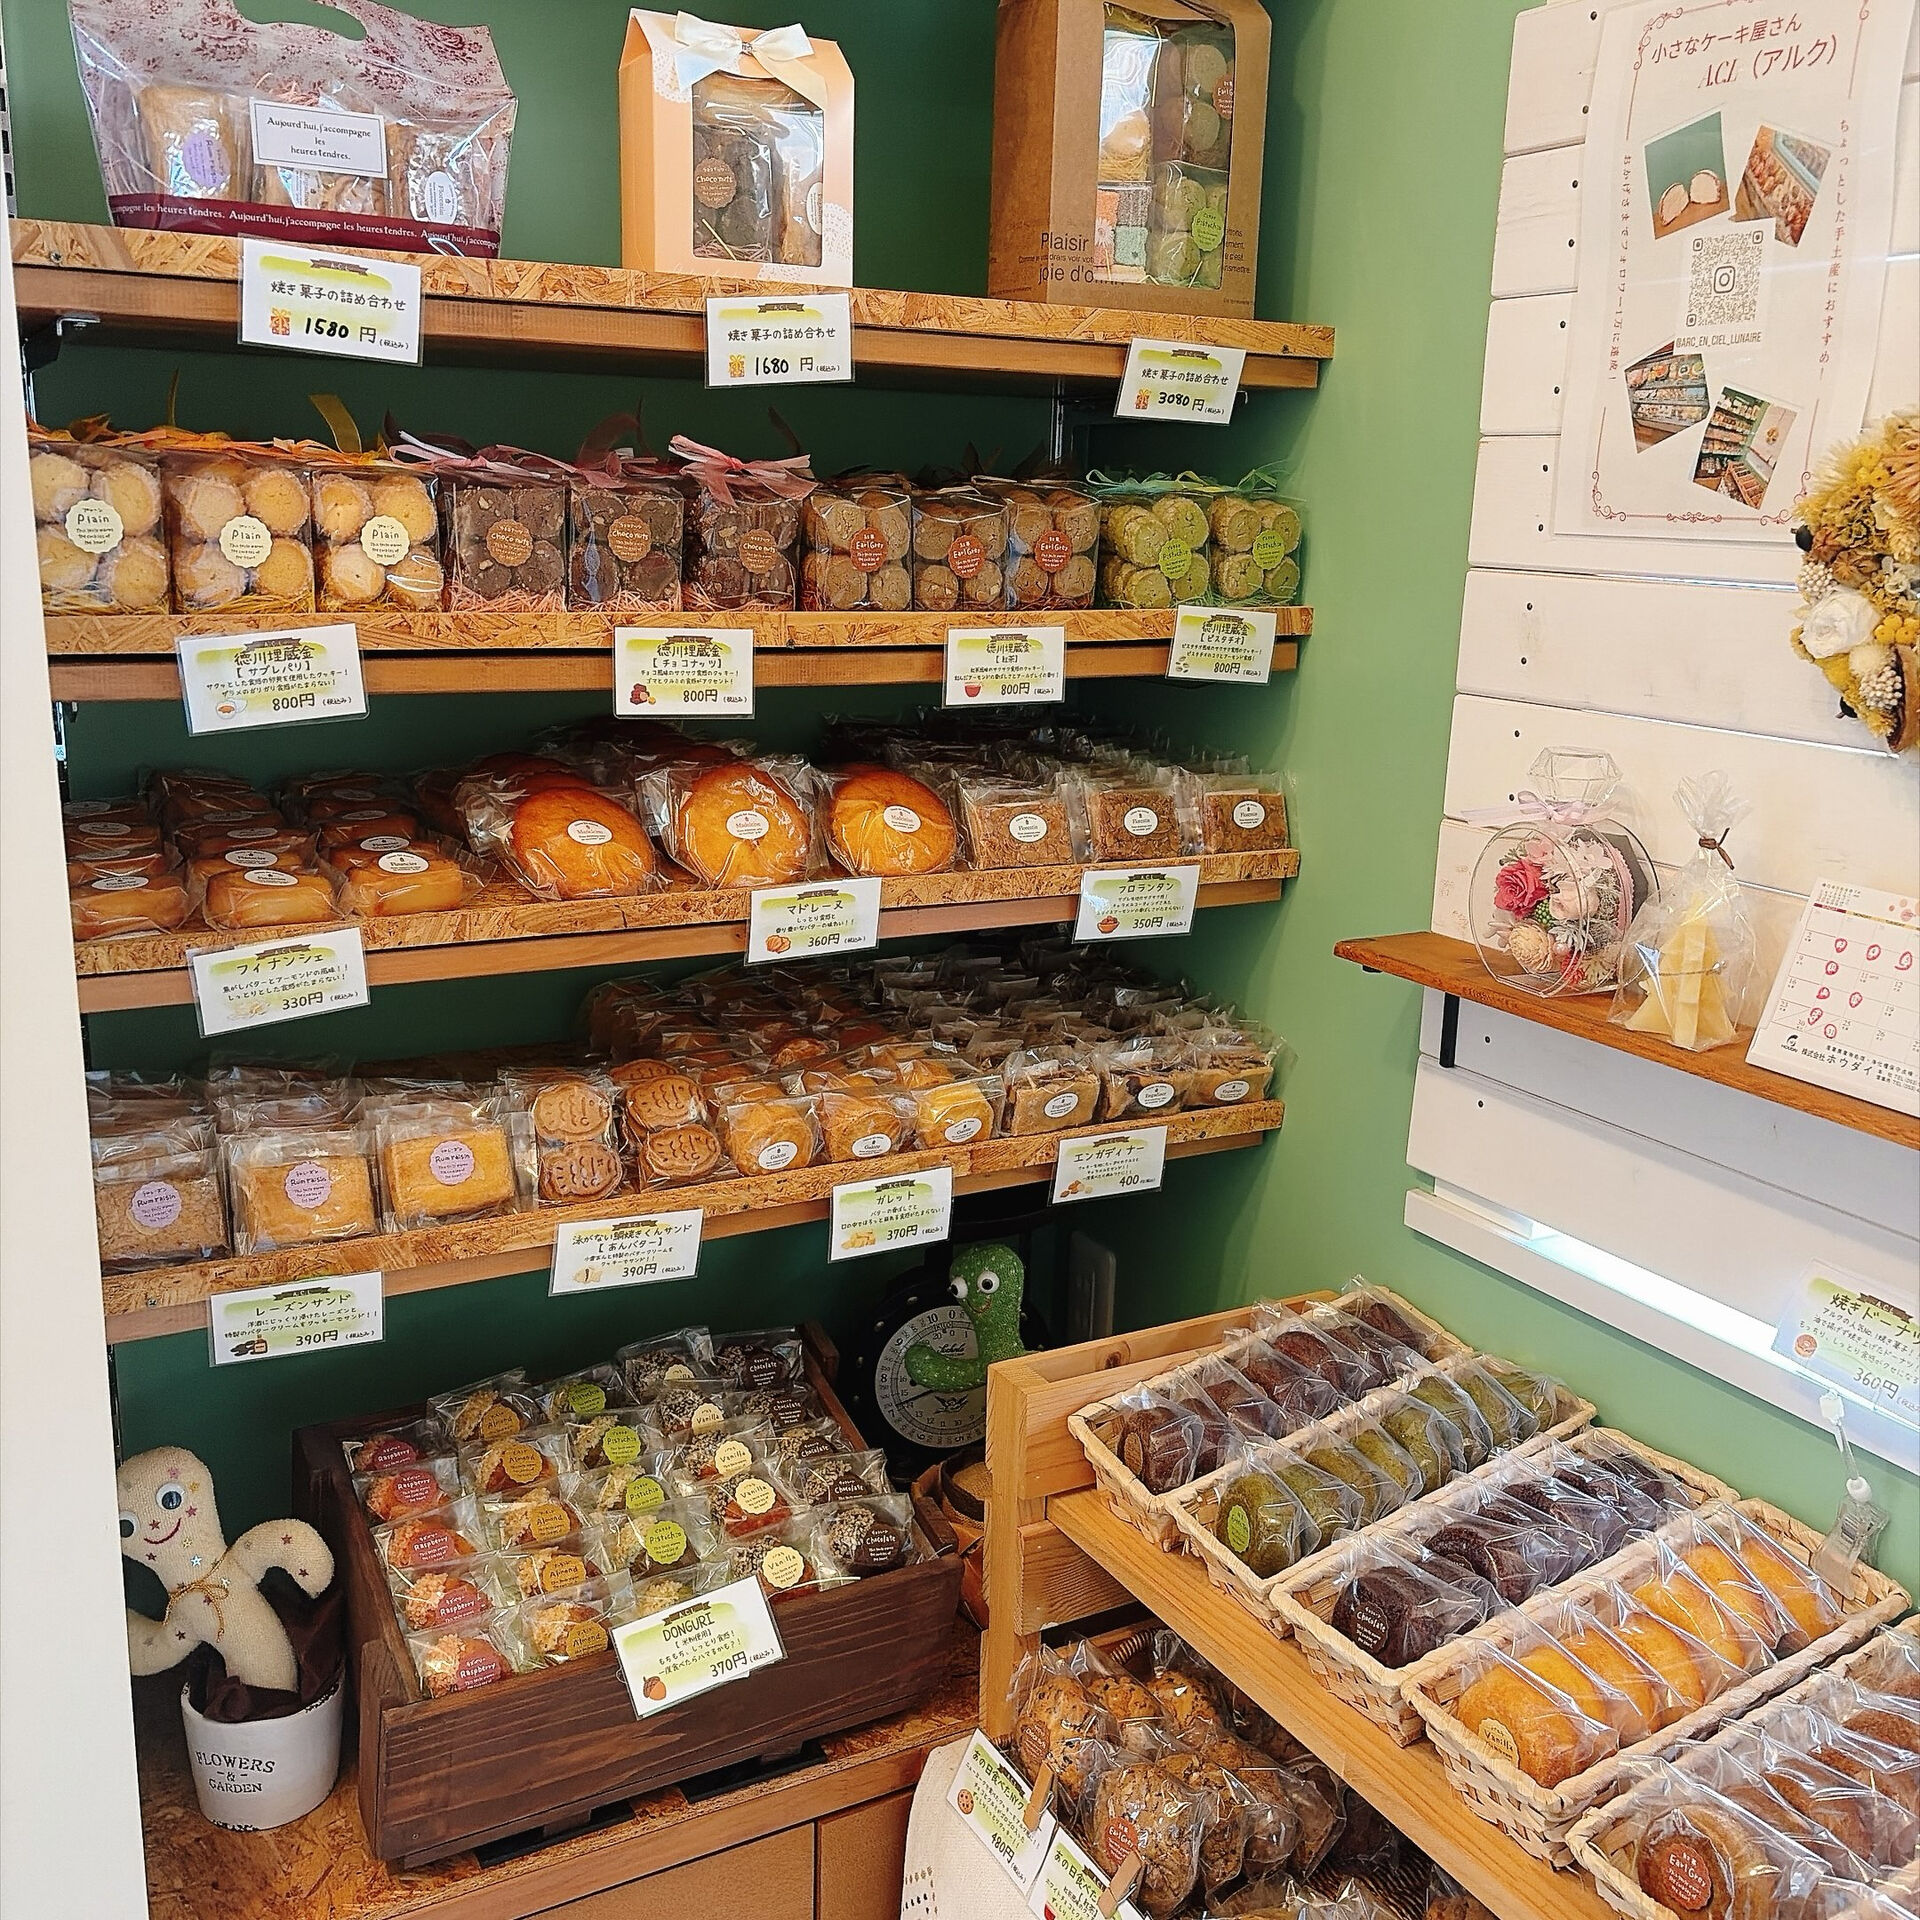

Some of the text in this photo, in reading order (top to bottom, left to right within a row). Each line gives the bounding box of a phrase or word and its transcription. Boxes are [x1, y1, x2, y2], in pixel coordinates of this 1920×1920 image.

[1651, 12, 1802, 64] 小さなケーキ屋さん
[314, 136, 326, 146] les
[290, 145, 351, 160] heures tendres.
[143, 203, 155, 213] les
[157, 204, 187, 215] heures
[188, 206, 225, 219] tendres.
[343, 221, 355, 231] les
[356, 224, 383, 234] heures
[384, 225, 417, 239] tendres.
[1041, 232, 1089, 252] Plaisir
[1038, 263, 1065, 286] joie
[270, 281, 406, 312] 焼き菓子の詰め合わせ
[305, 317, 350, 339] 1580
[359, 326, 377, 344] 円
[727, 326, 836, 342] 焼き菓子の詰め合わせ
[1675, 331, 1762, 348] @ARC_EN_CIEL_LUNAIRE
[755, 356, 789, 376] 1680
[800, 357, 814, 372] 円
[1141, 367, 1229, 386] 焼き菓子の詰め合わせ
[1158, 391, 1205, 412] 3080 円
[77, 513, 110, 525] Plain
[231, 529, 261, 540] Plain
[372, 529, 399, 540] Plain
[612, 530, 649, 541] Choco nuts
[856, 541, 869, 550] Earl
[953, 550, 966, 558] Earl
[234, 645, 315, 667] 徳川埋蔵金
[656, 644, 722, 658] 徳川埋蔵金
[1214, 662, 1240, 674] 800円
[683, 689, 718, 702] 800円
[1001, 682, 1030, 695] 800円
[272, 692, 315, 711] 800円
[1119, 882, 1174, 894] フロランタン
[787, 900, 843, 915] マドレーヌ
[1132, 916, 1163, 929] 350円
[808, 933, 840, 947] 360円
[237, 953, 324, 975] フィナンシェ
[282, 991, 323, 1010] 330円
[1074, 1145, 1144, 1162] エンガディナー
[290, 1179, 306, 1187] Rum
[1119, 1174, 1140, 1187] 400
[137, 1198, 154, 1207] Rum
[876, 1190, 915, 1205] ガレット
[887, 1224, 918, 1240] 370円
[622, 1262, 657, 1278] 390円
[256, 1294, 352, 1317] レーズンサンド
[295, 1329, 338, 1346] 390円
[1853, 1367, 1900, 1400] 360円
[696, 1413, 720, 1424] Vanilla
[719, 1450, 746, 1463] Vanilla
[740, 1485, 767, 1499] Vanilla
[768, 1554, 796, 1570] Vanilla
[662, 1612, 716, 1642] DONGURI
[1356, 1611, 1386, 1633] Chocolate
[710, 1651, 748, 1677] 370円
[1483, 1728, 1514, 1752] Vanilla
[195, 1750, 276, 1774] FLOWERS
[208, 1778, 263, 1794] GARDEN
[991, 1831, 1016, 1864] 480円
[1669, 1854, 1688, 1873] Earl
[1687, 1867, 1706, 1888] Grey
